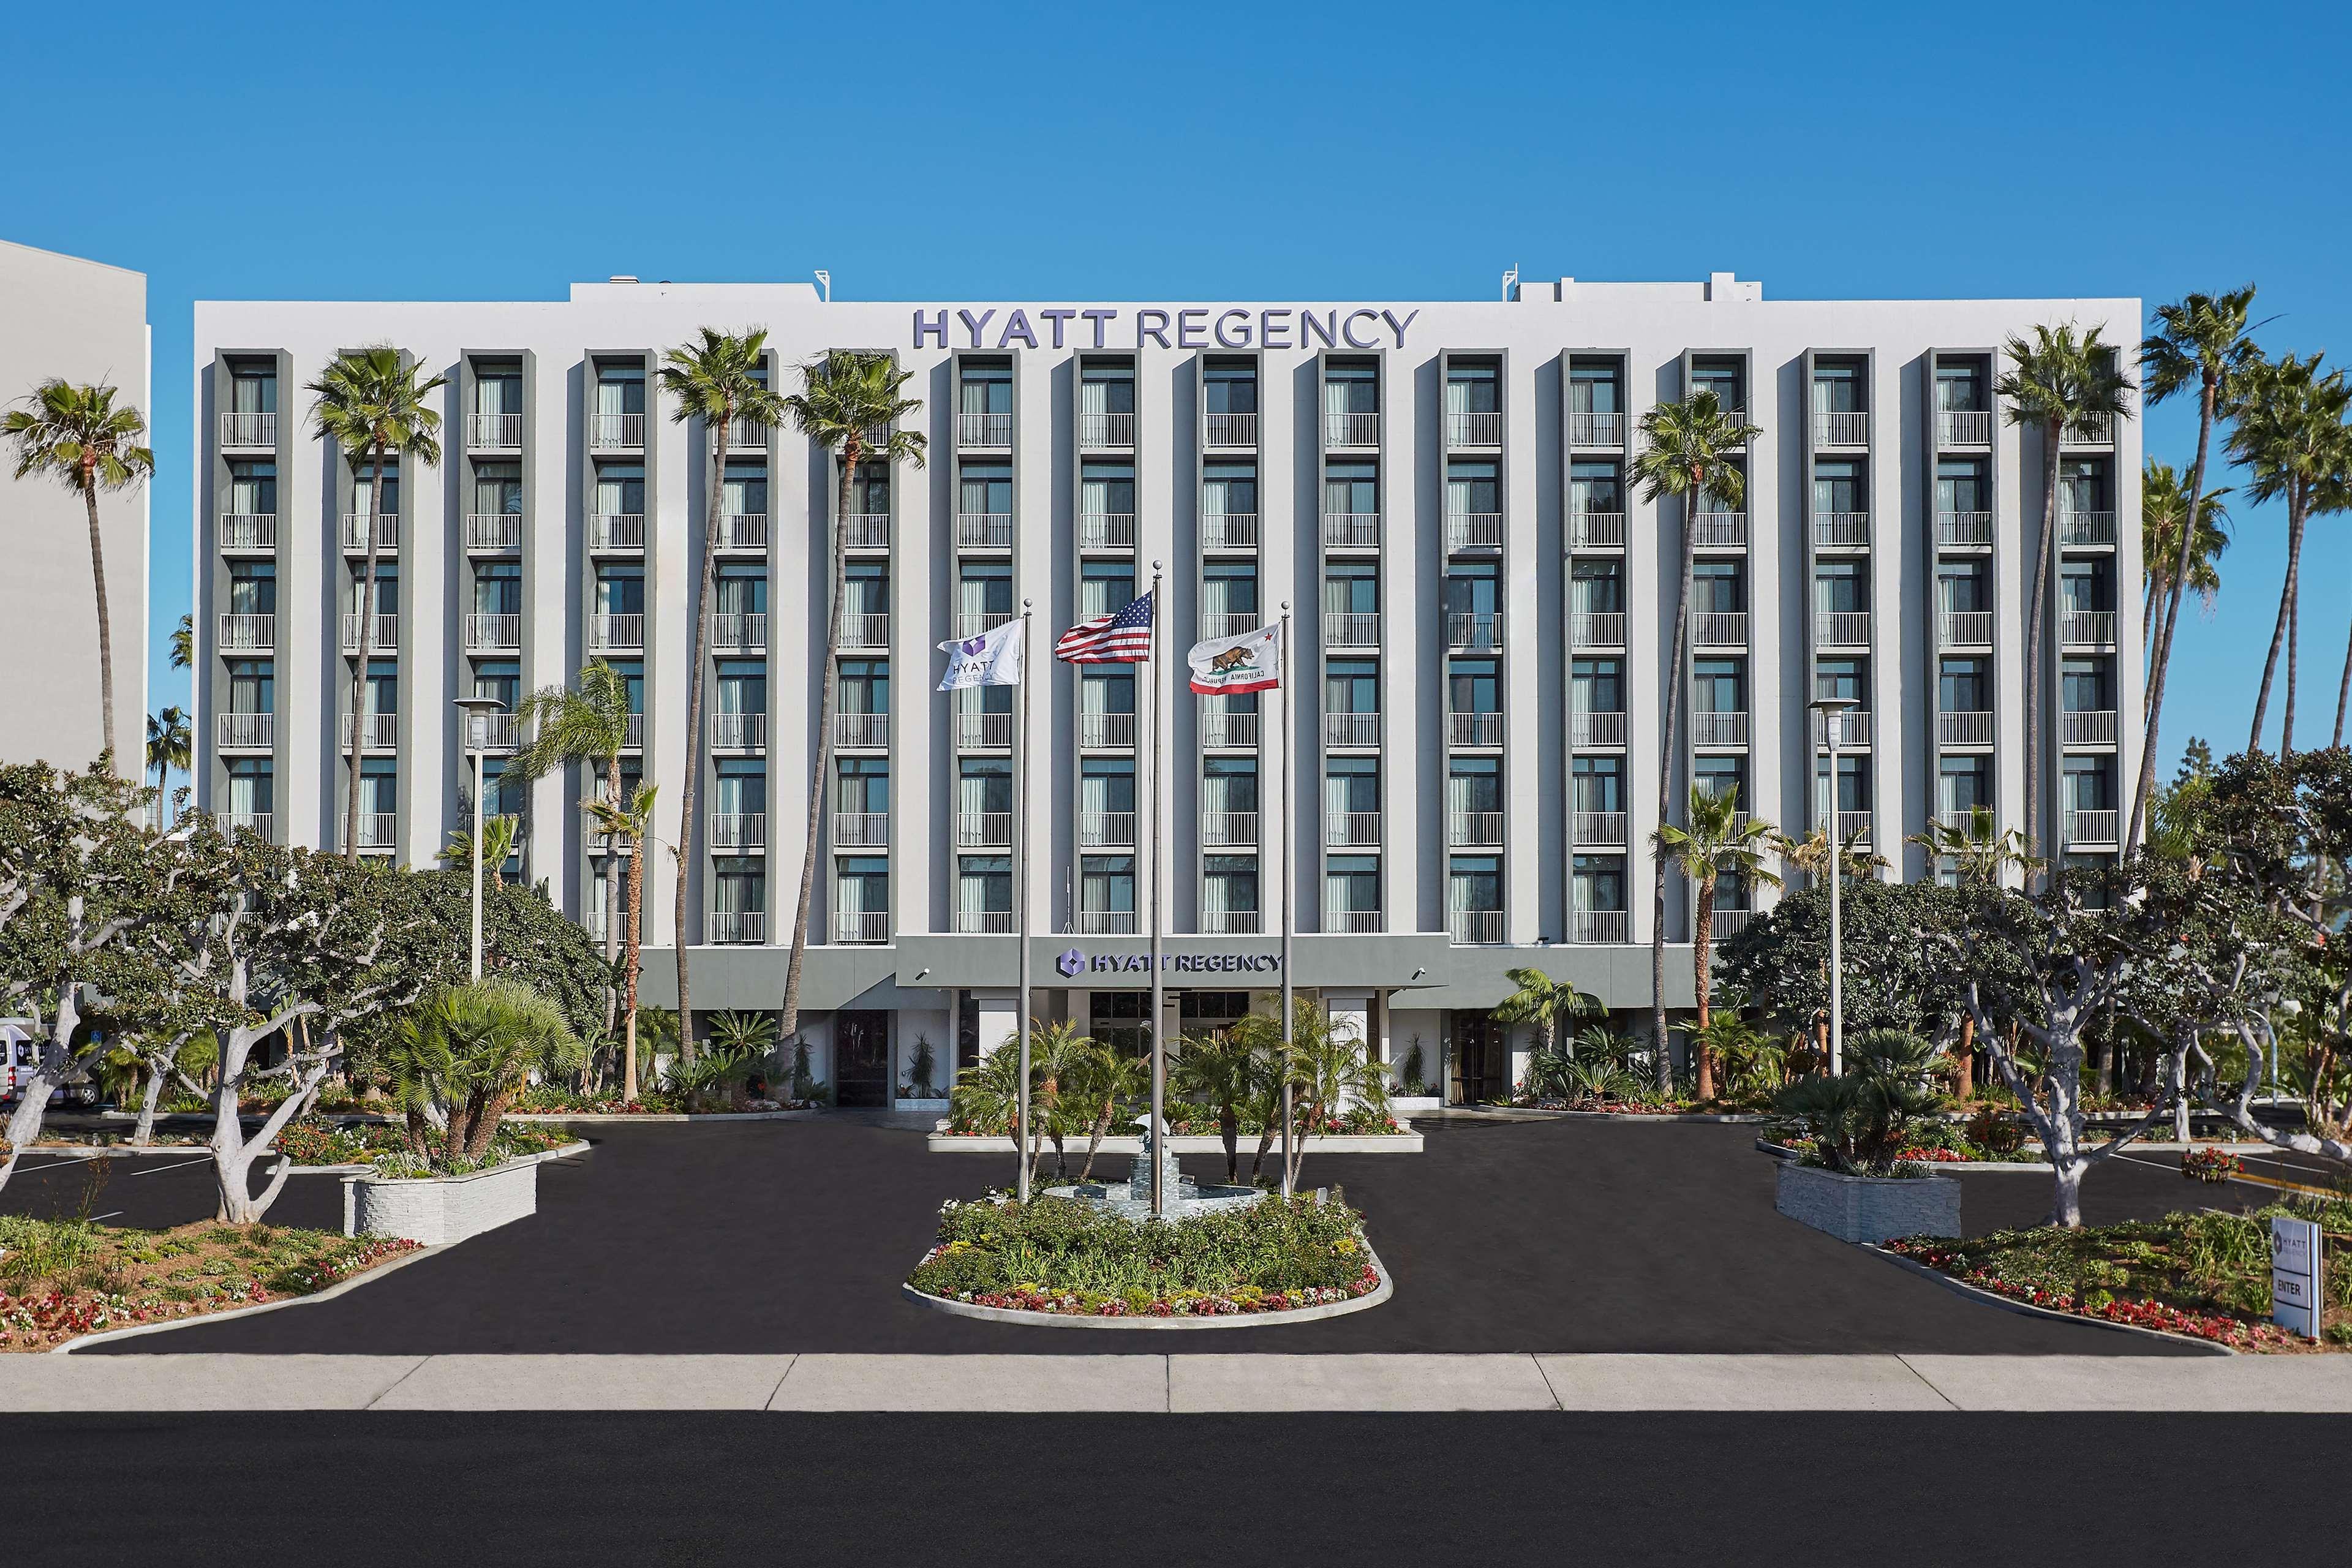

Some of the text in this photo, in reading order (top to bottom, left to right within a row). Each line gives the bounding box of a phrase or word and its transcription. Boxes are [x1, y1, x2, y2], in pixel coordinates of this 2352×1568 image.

[913, 309, 1420, 349] HYATT REGENCY
[953, 660, 994, 674] HYATT
[952, 672, 993, 684] REGENCY
[1092, 954, 1283, 971] HYATT REGENCY
[2283, 1238, 2305, 1249] HYATT
[2278, 1279, 2301, 1296] ENTER
